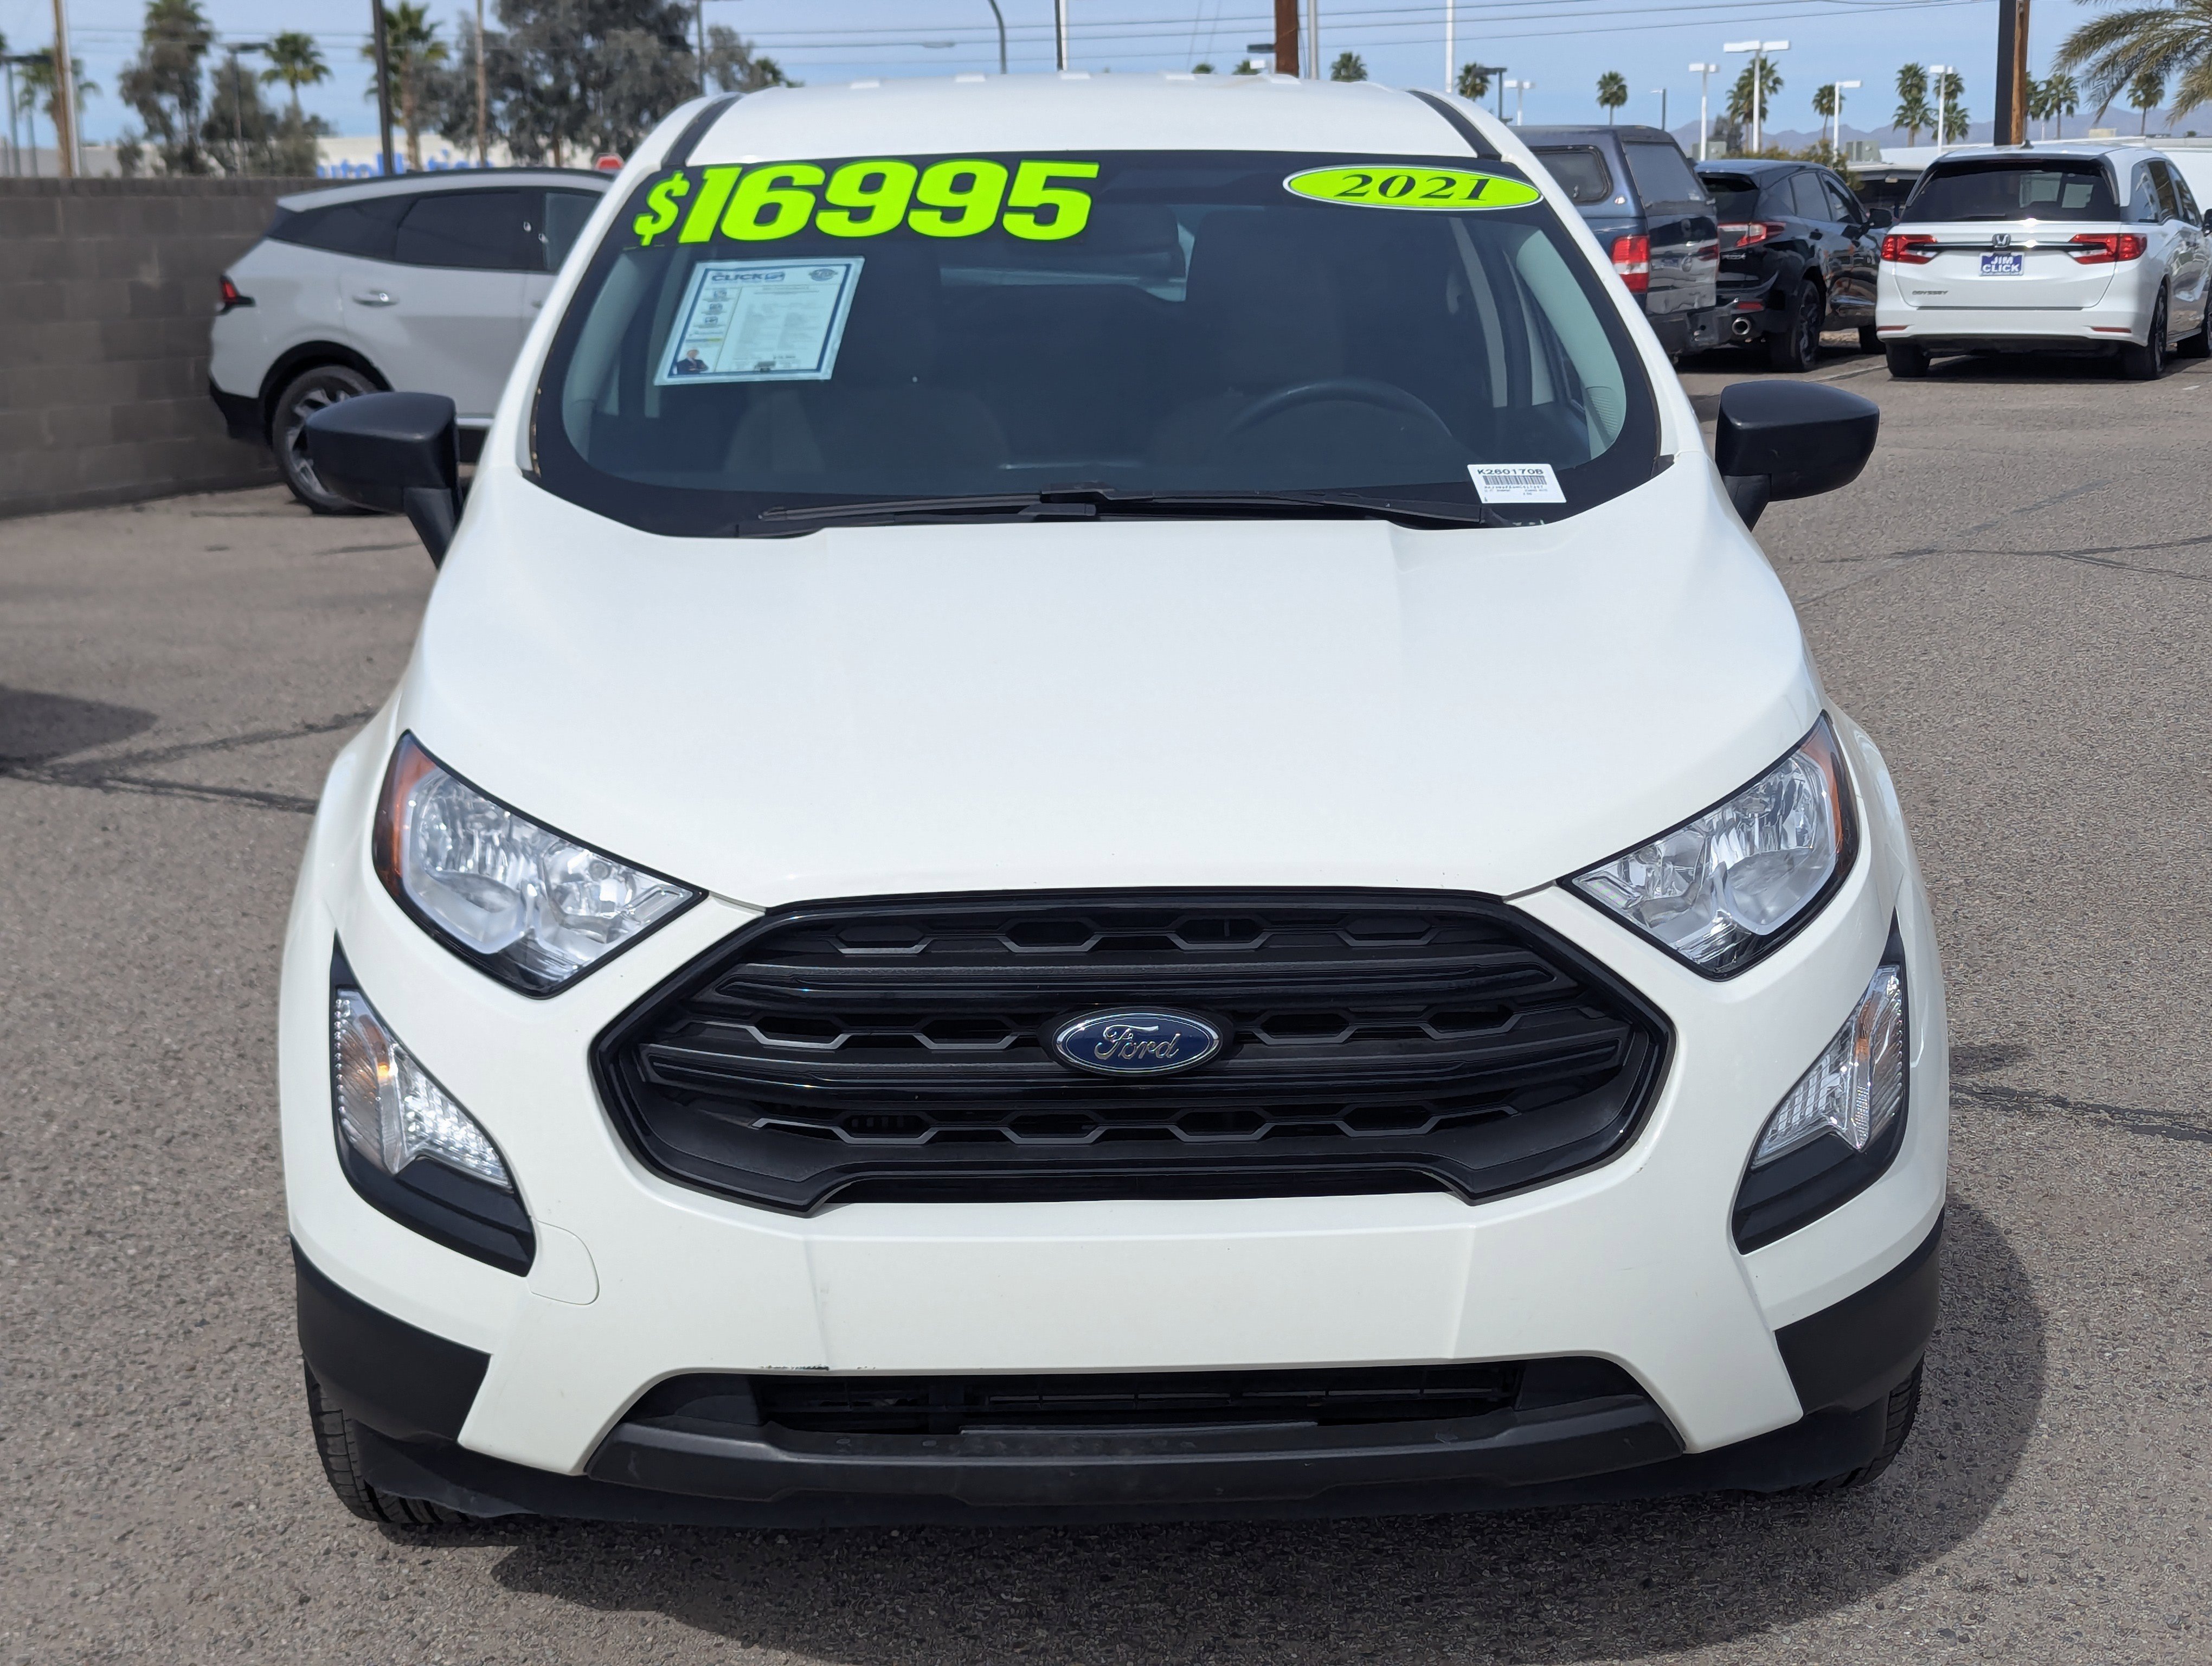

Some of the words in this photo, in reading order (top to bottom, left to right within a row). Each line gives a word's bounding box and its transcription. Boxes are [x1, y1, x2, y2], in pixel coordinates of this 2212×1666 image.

[1334, 174, 1491, 201] 2021
[633, 158, 1100, 247] $16995
[1982, 264, 2020, 272] CLICK
[1991, 256, 2014, 265] JIM
[1094, 1024, 1181, 1060] Ford
